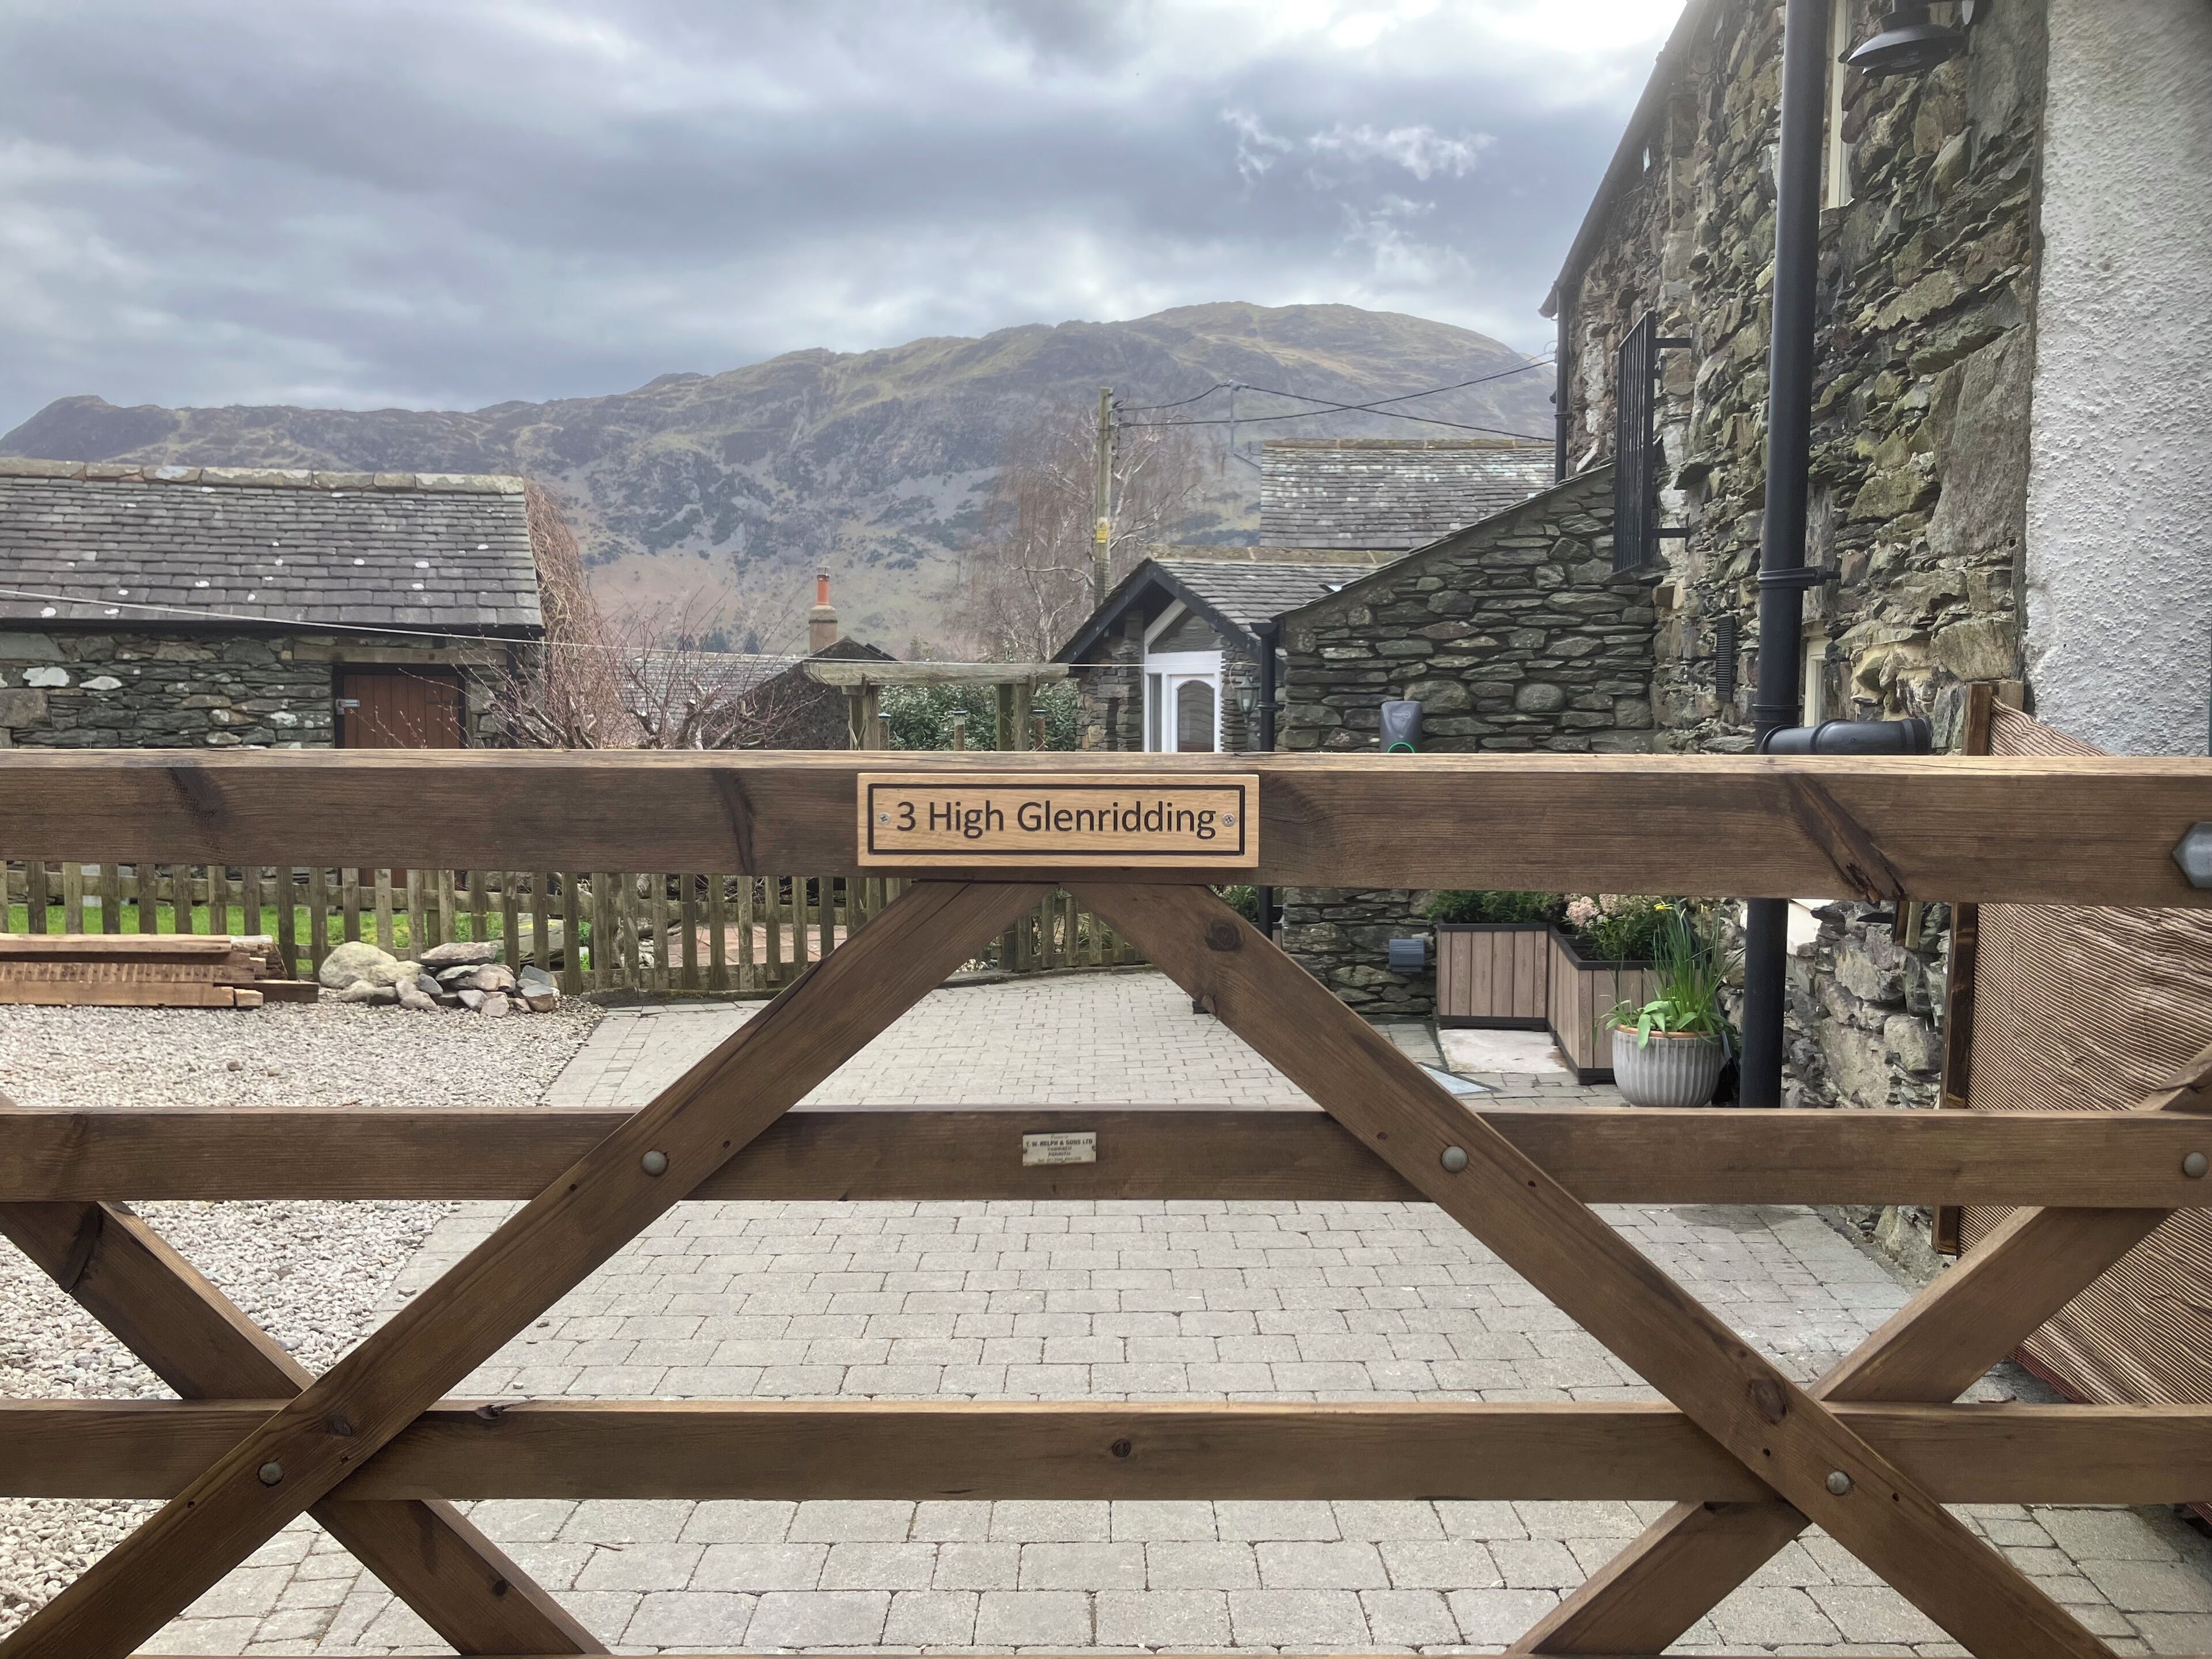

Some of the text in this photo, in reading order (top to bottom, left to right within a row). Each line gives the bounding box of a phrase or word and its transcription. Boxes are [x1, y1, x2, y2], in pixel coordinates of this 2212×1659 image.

[896, 800, 1216, 840] 3 High Glenridding
